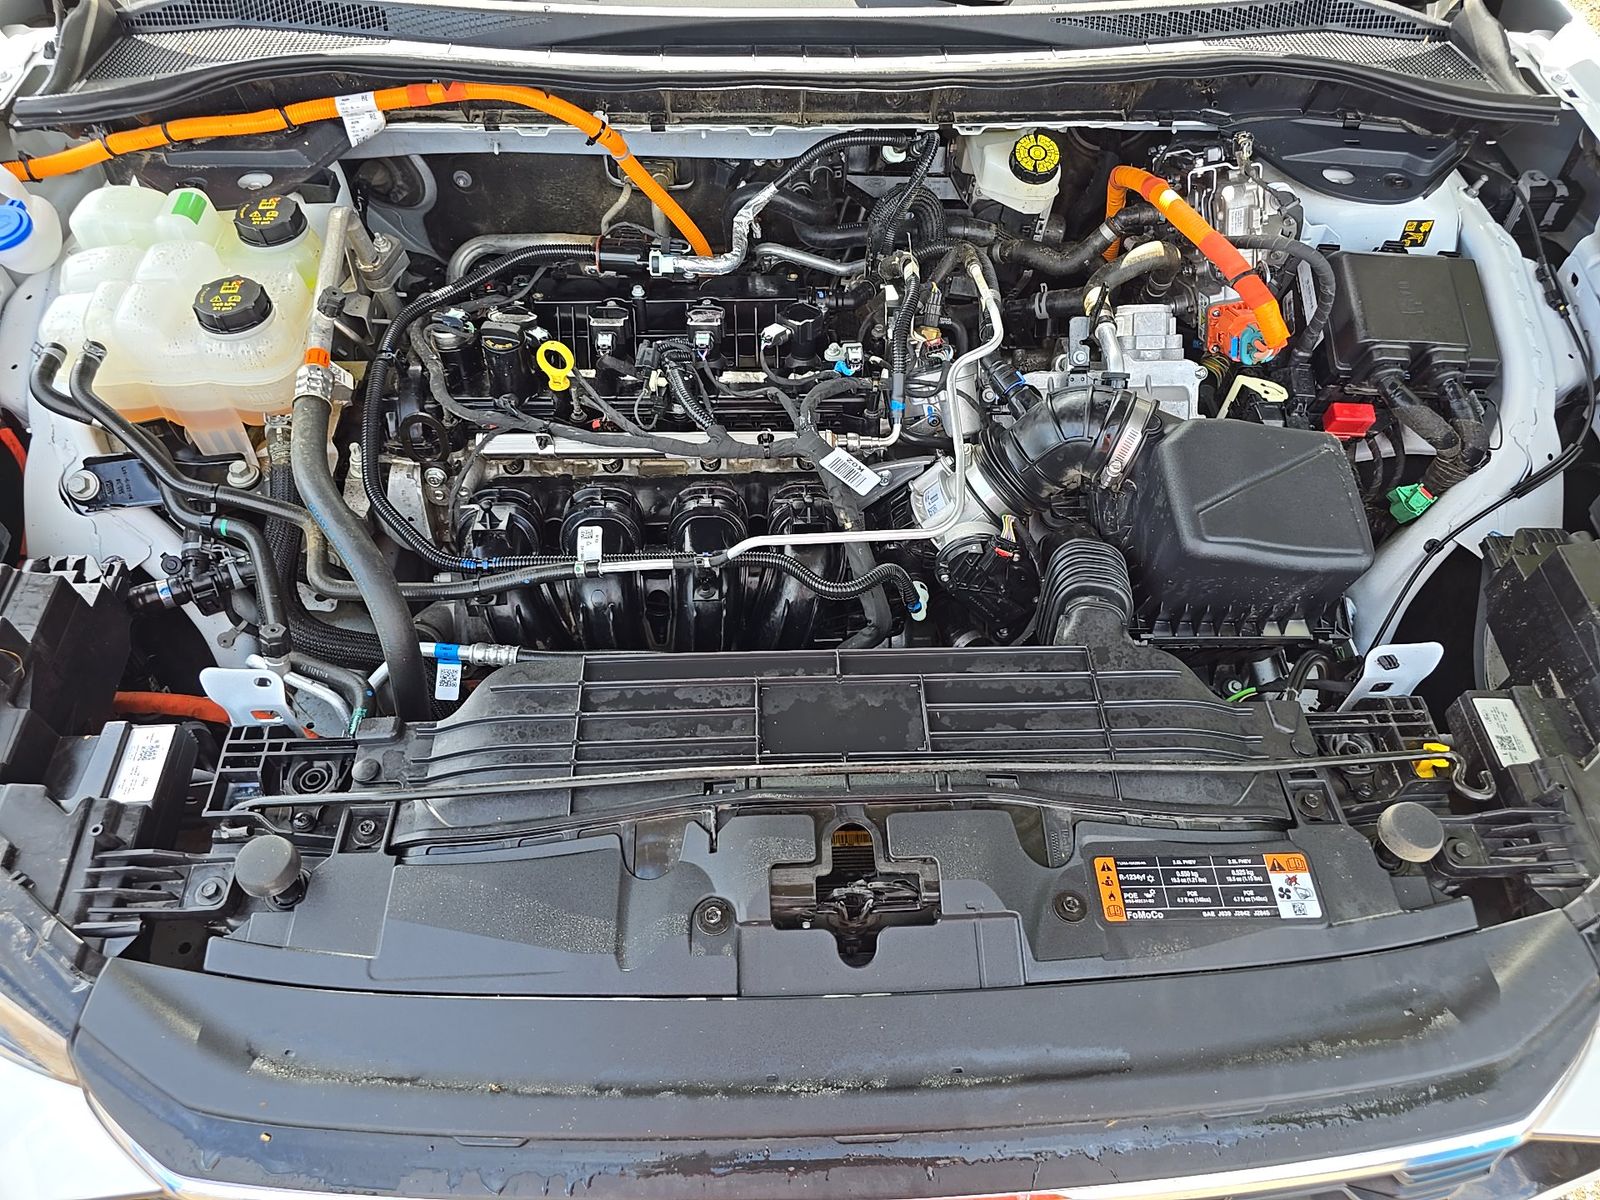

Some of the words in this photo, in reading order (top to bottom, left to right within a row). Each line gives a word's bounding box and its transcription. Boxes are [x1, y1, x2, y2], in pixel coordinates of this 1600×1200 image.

[846, 457, 865, 473] K02
[1118, 873, 1147, 882] R-1234yf
[1127, 910, 1164, 919] FoMoCo
